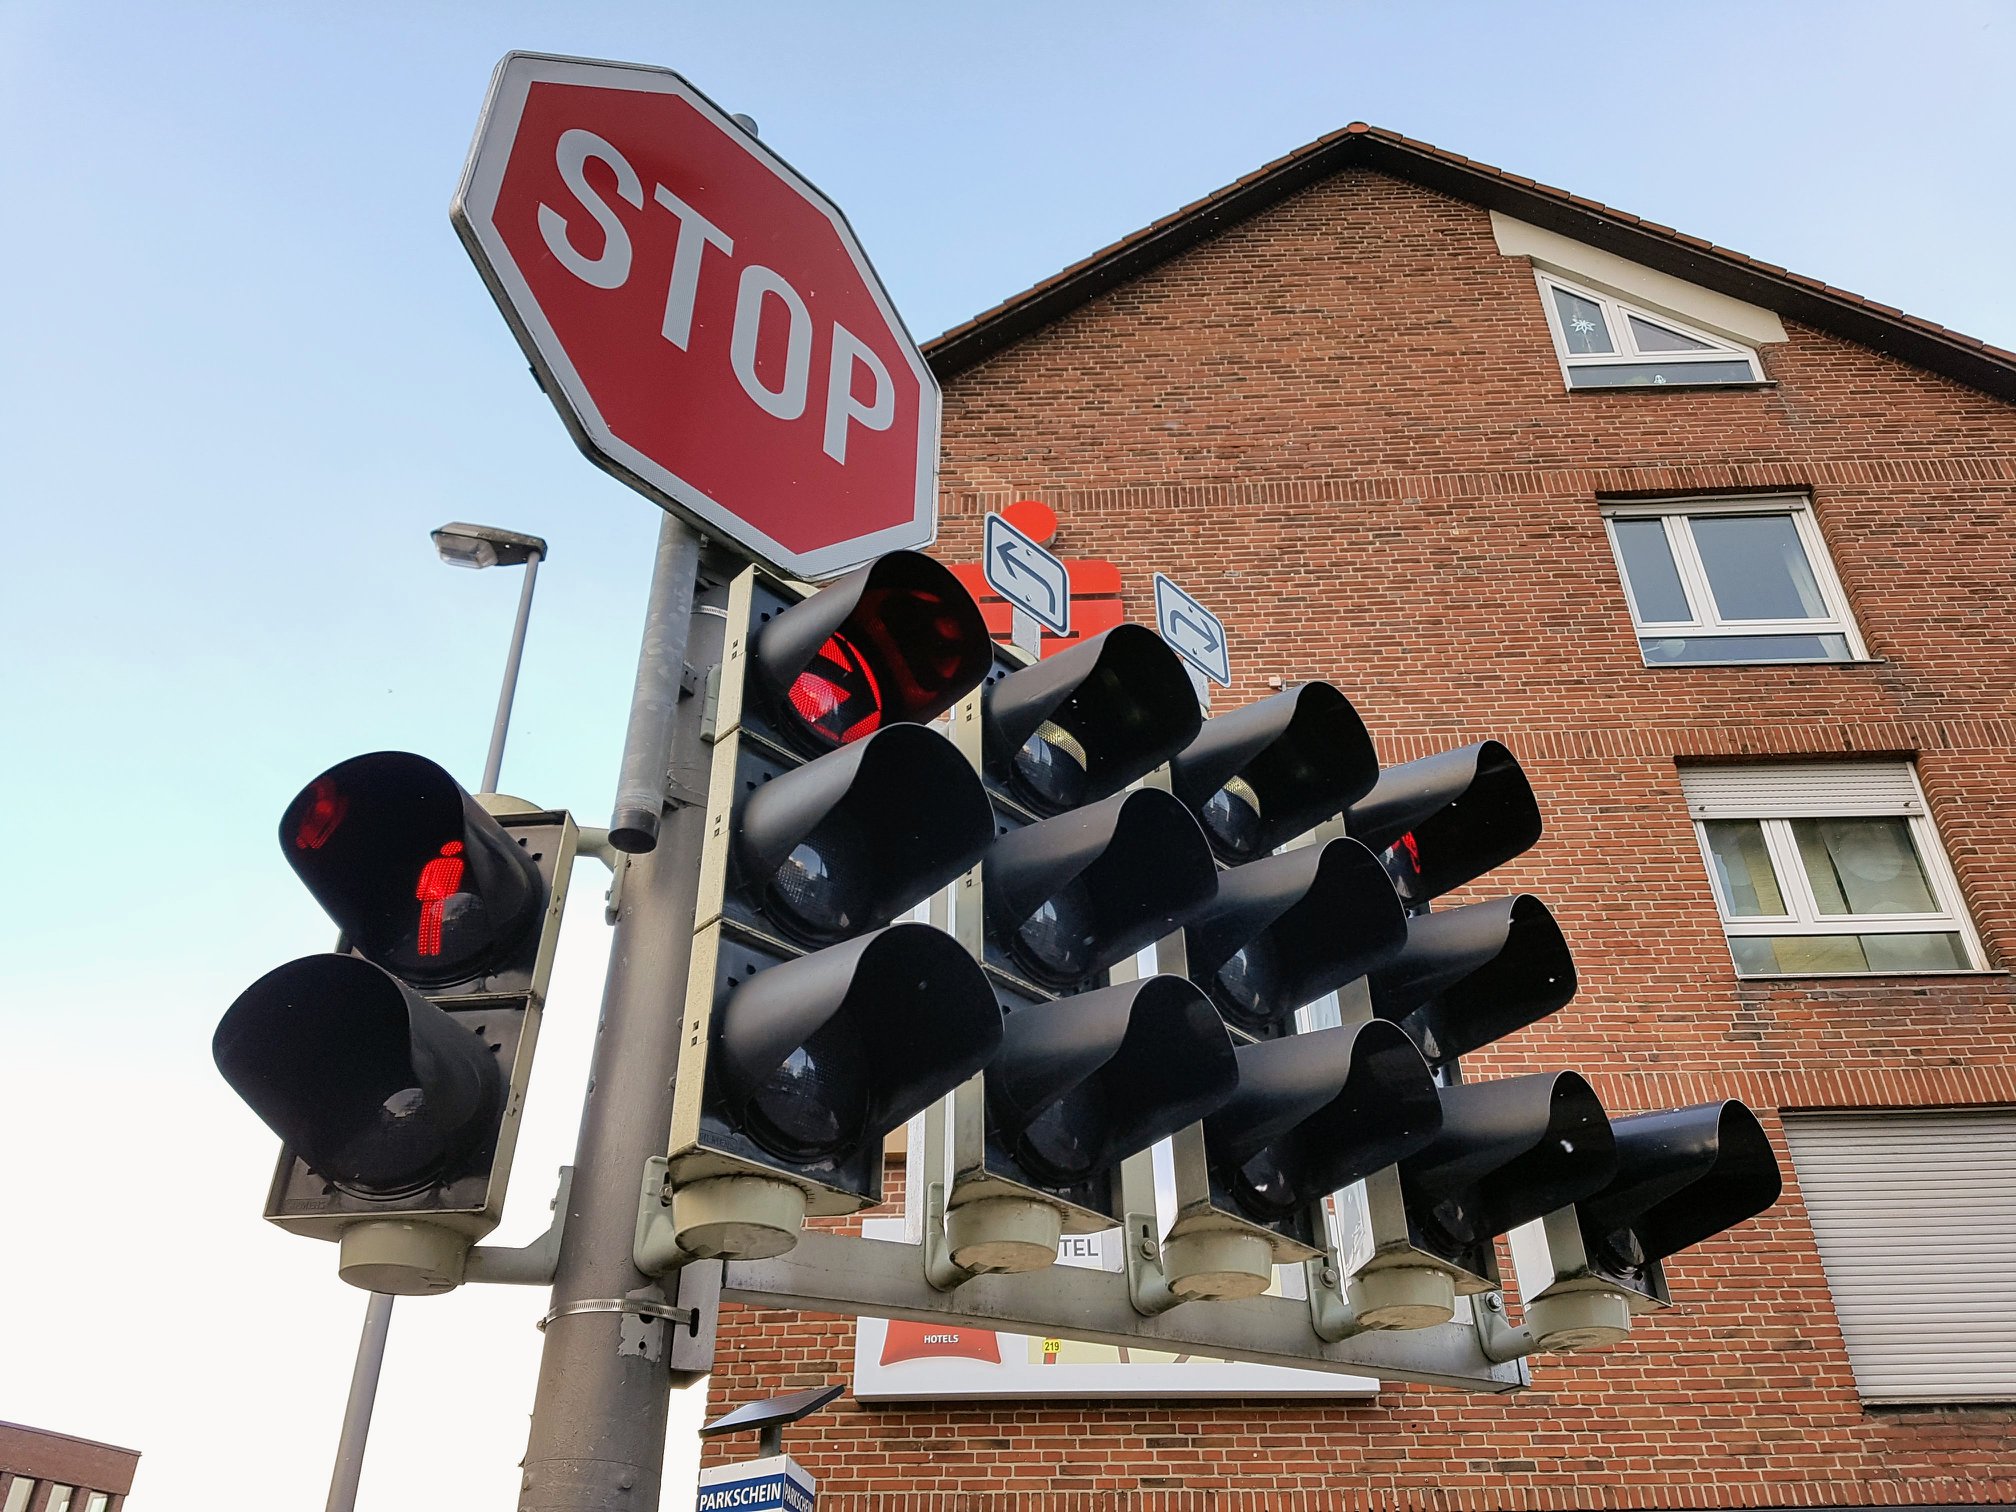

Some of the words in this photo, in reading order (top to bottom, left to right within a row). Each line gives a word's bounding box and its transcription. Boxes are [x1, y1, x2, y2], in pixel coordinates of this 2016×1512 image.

[537, 128, 895, 466] STOP
[923, 1334, 959, 1344] HOTELS
[1044, 1341, 1060, 1351] 219
[699, 1482, 782, 1511] PARKSCHEIN
